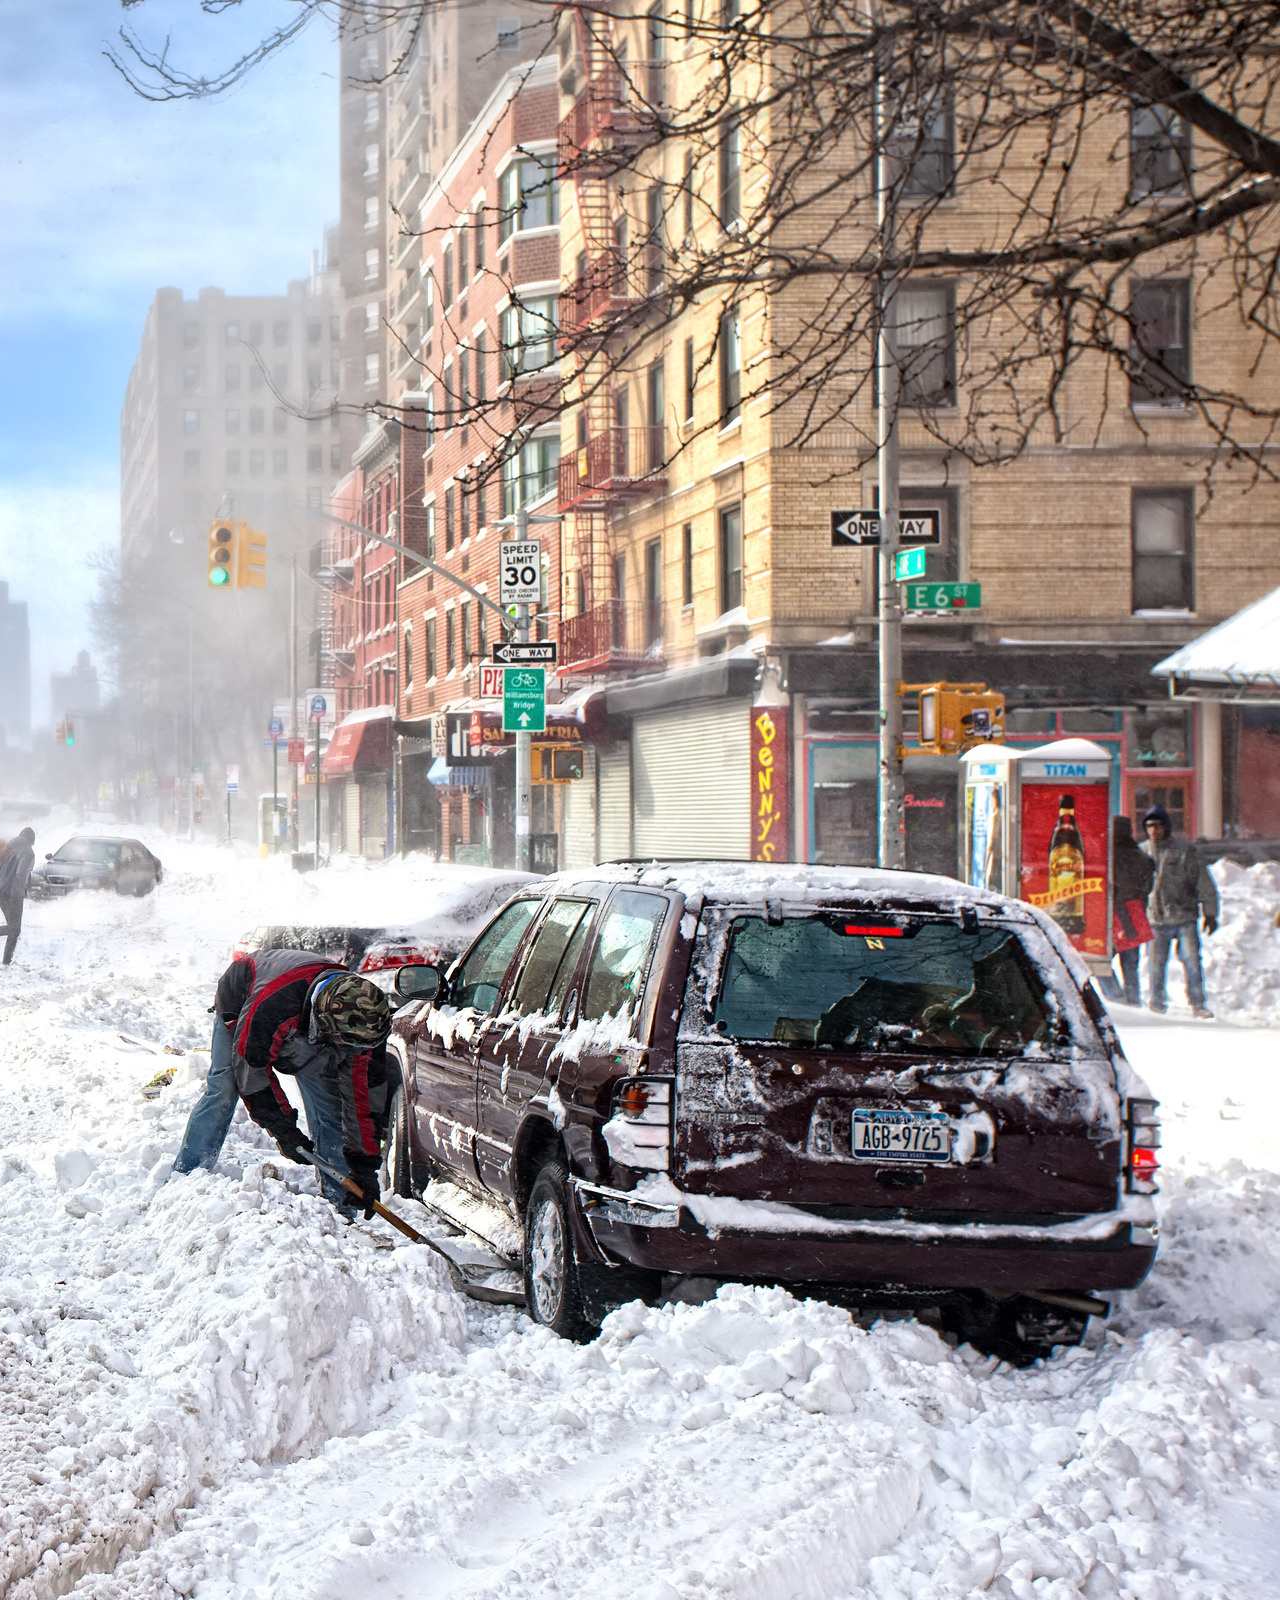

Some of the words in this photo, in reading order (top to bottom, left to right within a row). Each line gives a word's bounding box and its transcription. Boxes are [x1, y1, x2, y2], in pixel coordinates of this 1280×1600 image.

[848, 521, 879, 536] ONE
[503, 545, 538, 554] SPEED
[506, 556, 533, 565] LIMIT
[504, 566, 537, 586] 30
[915, 587, 928, 607] E
[935, 586, 949, 607] 6
[953, 585, 968, 597] ST
[502, 649, 520, 658] ONE
[528, 649, 548, 657] WAY
[505, 692, 544, 700] Williamsburg
[513, 702, 535, 711] Bridge
[1044, 764, 1087, 776] TITAN
[1034, 880, 1097, 906] DELICIOSO
